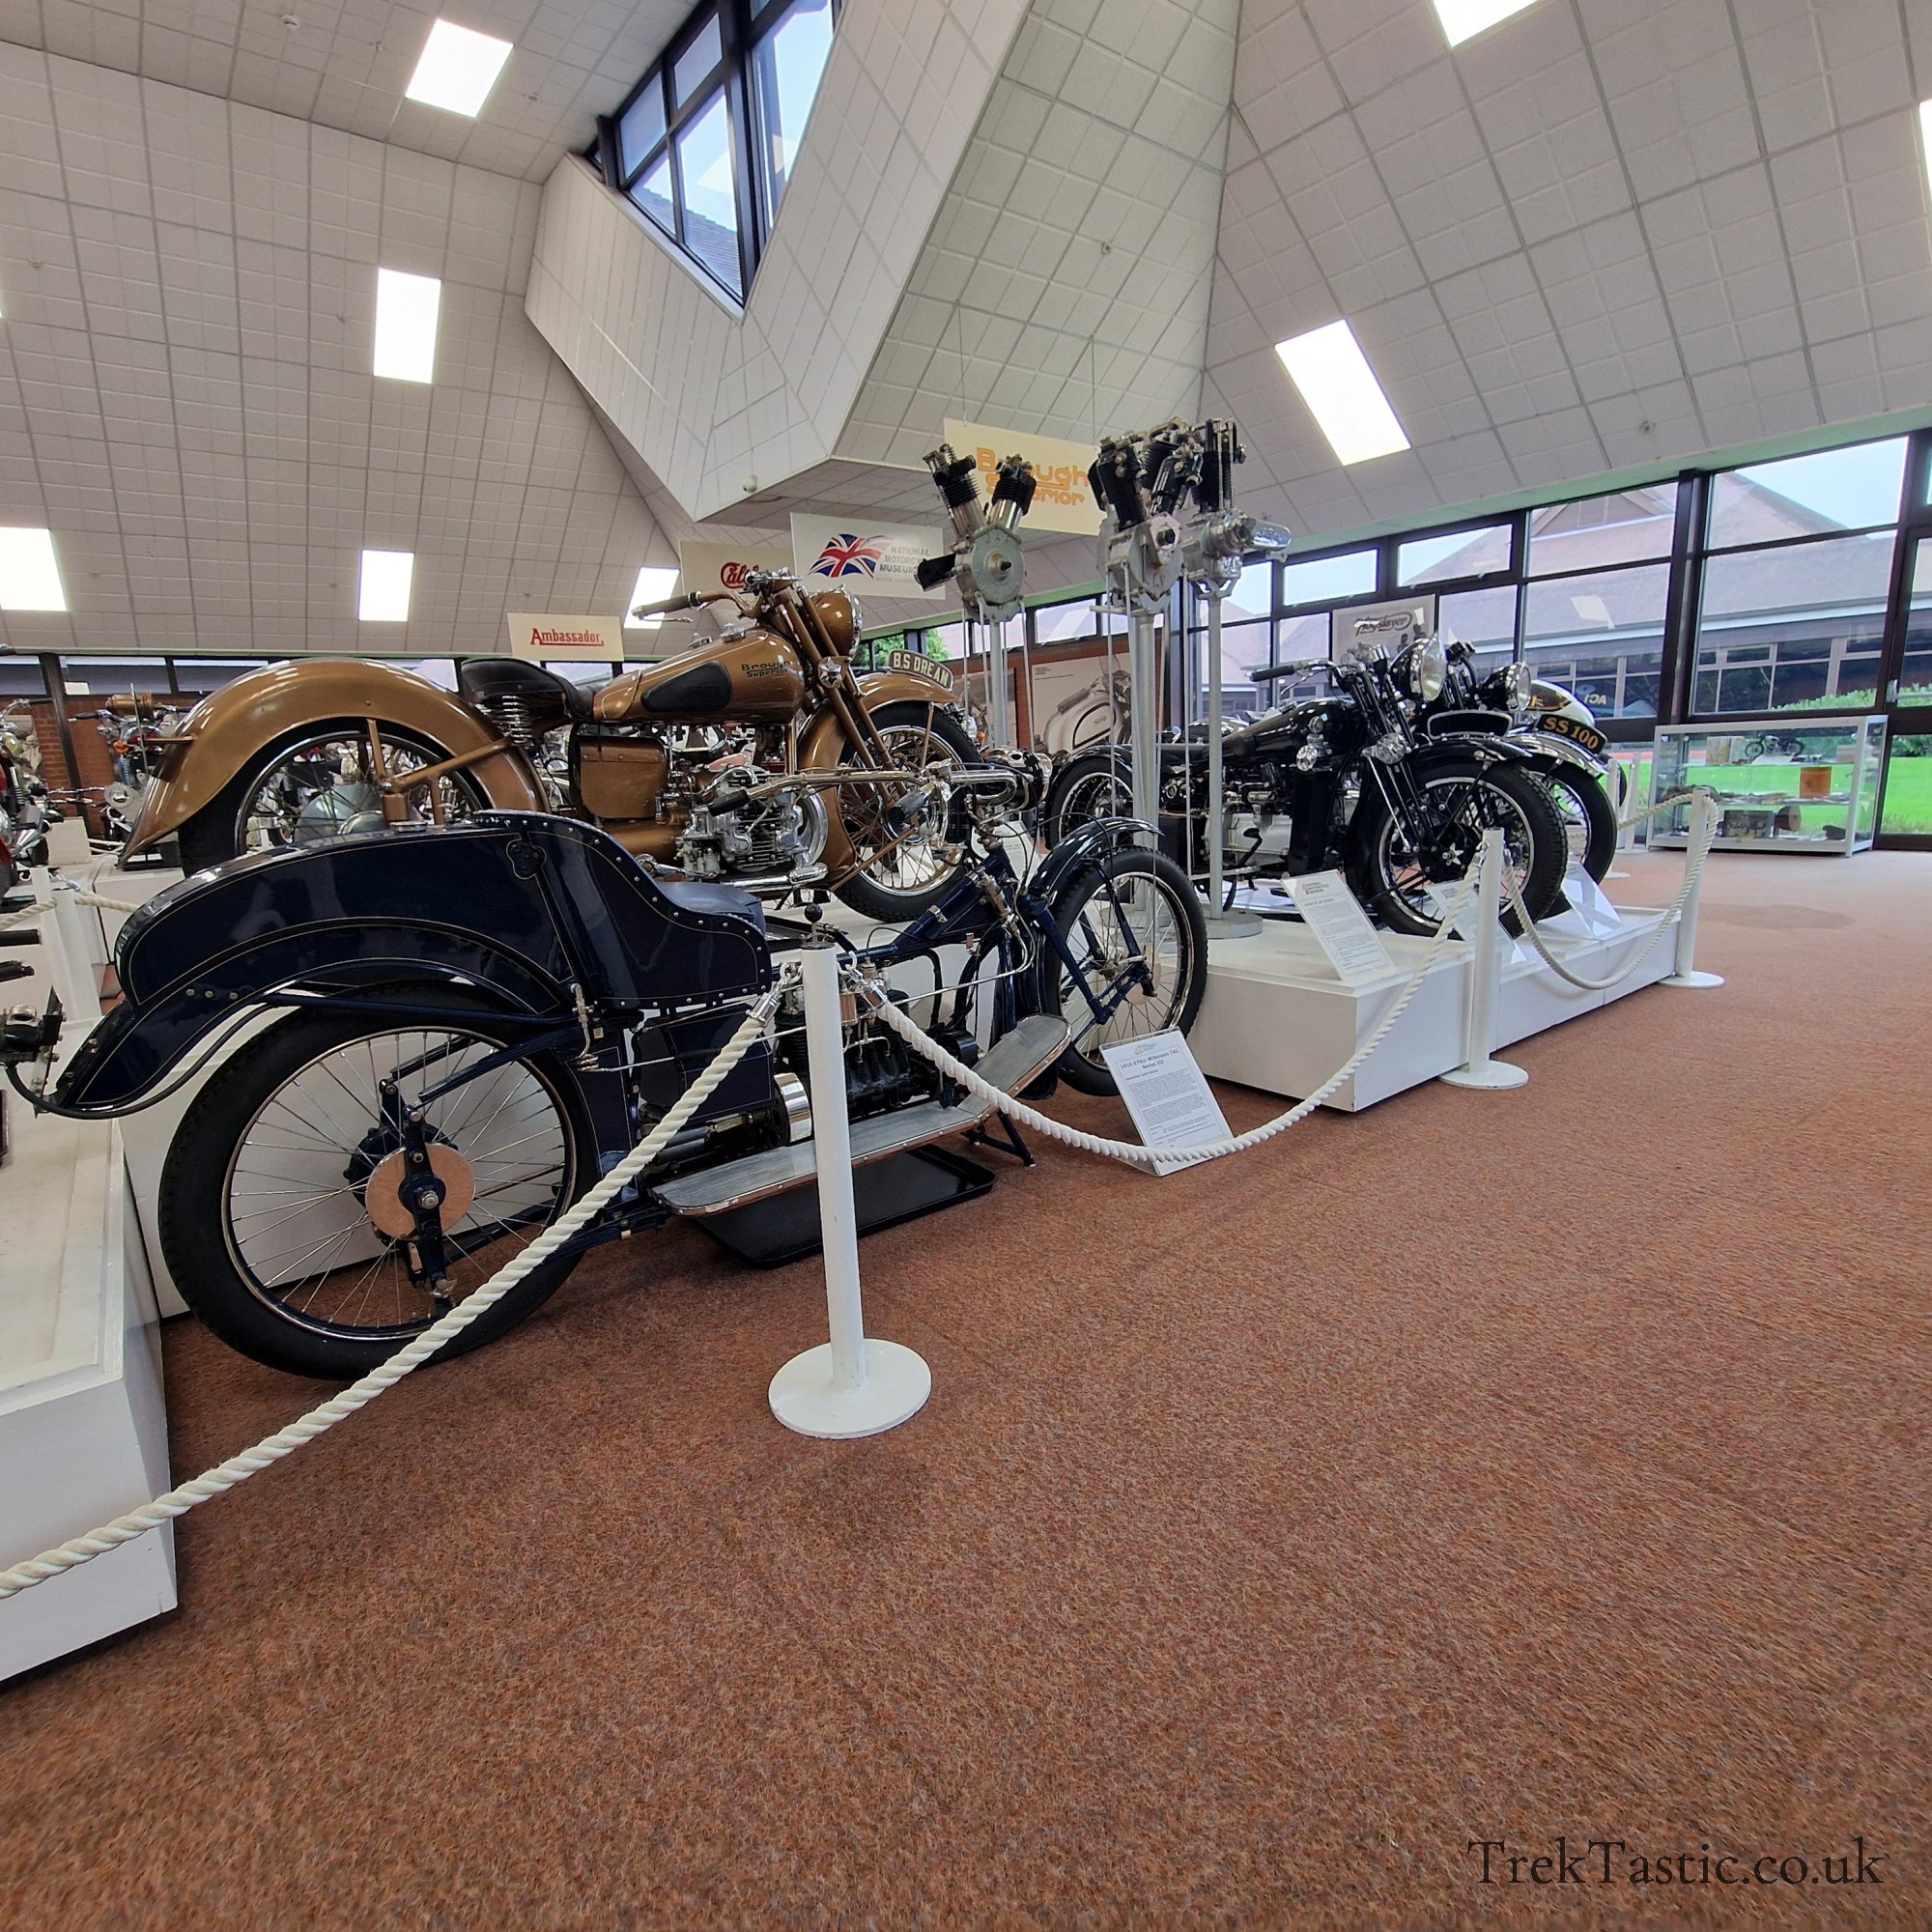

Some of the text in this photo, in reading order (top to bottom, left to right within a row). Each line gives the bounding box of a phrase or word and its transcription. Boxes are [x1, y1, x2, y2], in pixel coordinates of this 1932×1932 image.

[977, 447, 1089, 491] Bugh
[891, 546, 930, 557] NATIONAL
[529, 628, 605, 646] Ambassador
[741, 660, 790, 672] Brough
[746, 668, 788, 678] Superior
[913, 656, 950, 688] DREAM
[1543, 717, 1599, 750] SS 100
